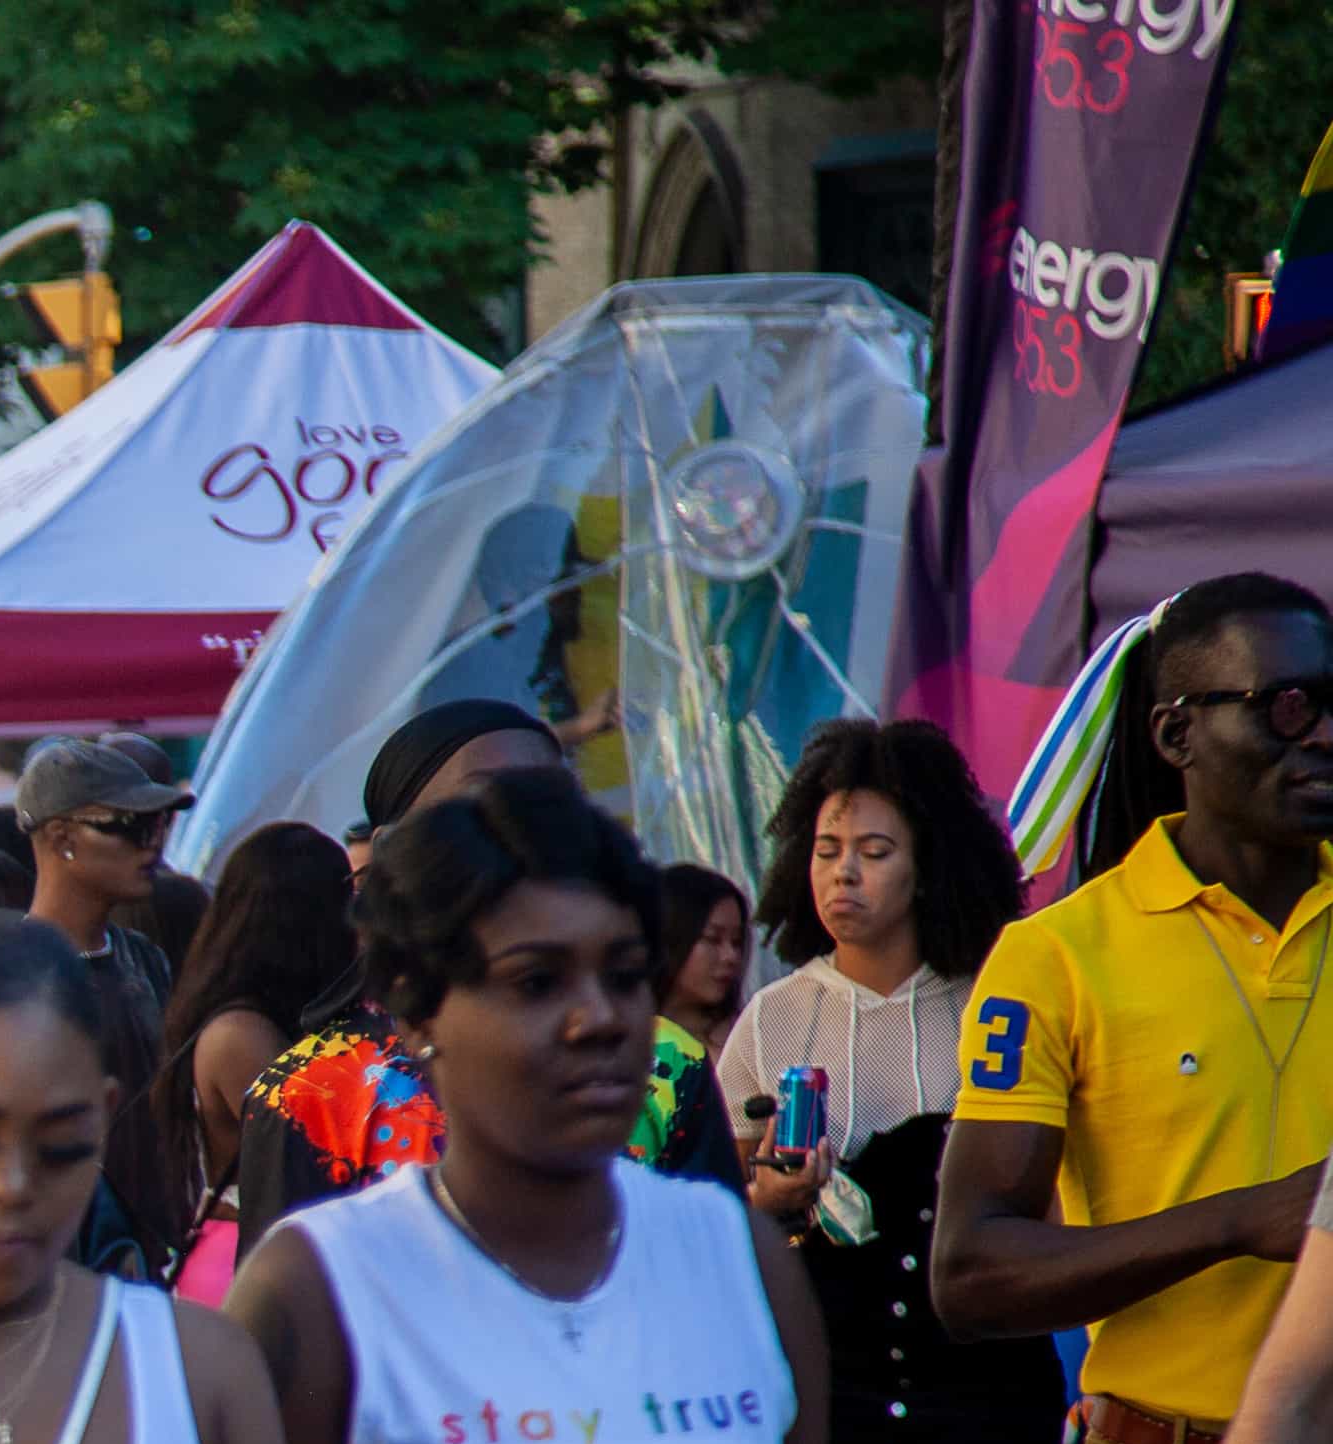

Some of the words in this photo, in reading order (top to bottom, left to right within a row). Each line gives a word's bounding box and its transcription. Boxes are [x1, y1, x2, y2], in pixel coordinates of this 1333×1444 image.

[294, 415, 401, 447] love
[970, 995, 1031, 1092] 3
[644, 1390, 762, 1434] true
